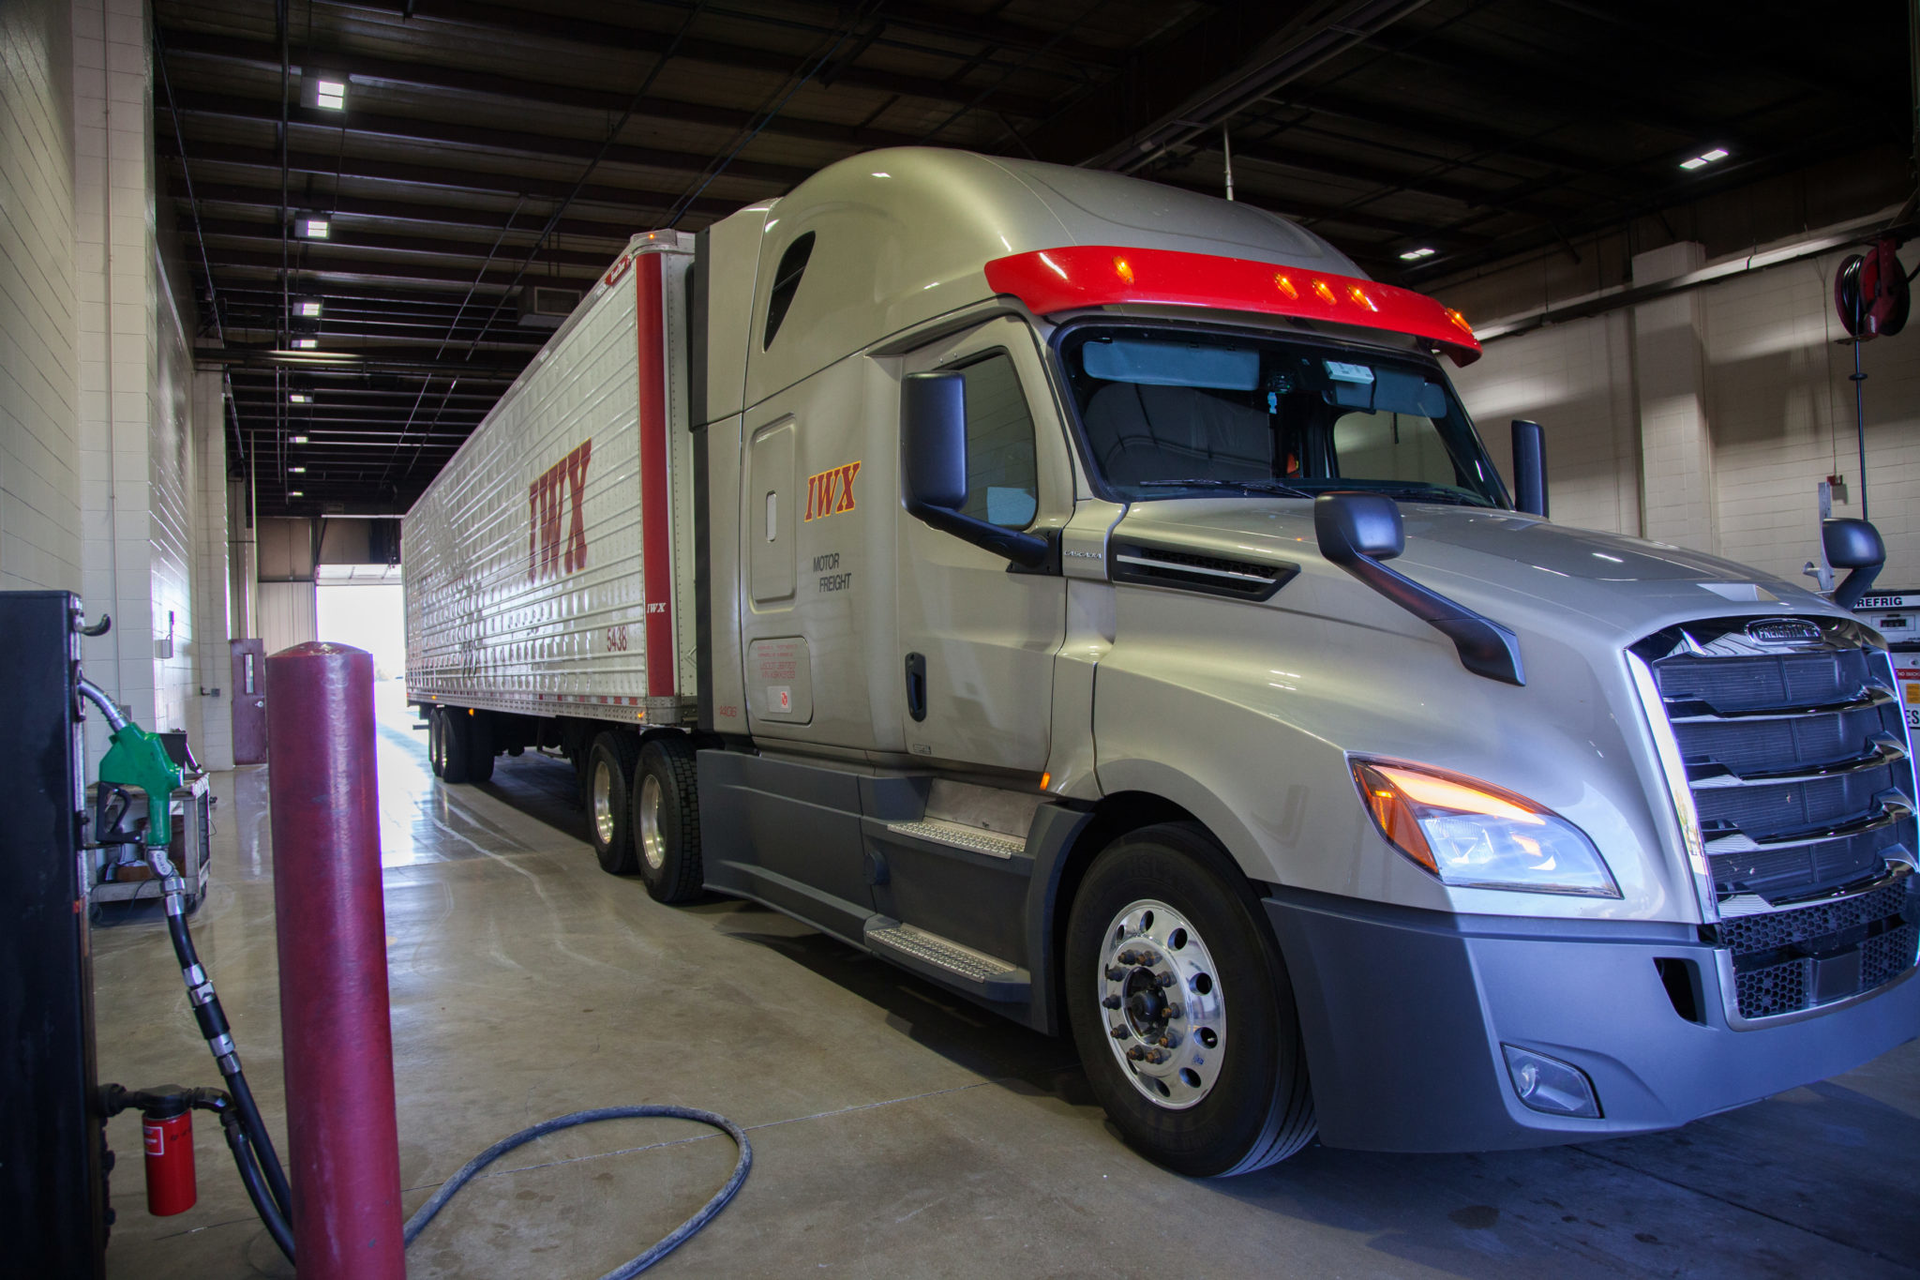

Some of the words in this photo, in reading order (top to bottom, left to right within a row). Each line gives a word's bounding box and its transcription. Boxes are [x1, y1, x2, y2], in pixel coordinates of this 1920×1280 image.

[804, 460, 862, 522] IWX
[529, 437, 592, 584] IWX
[813, 552, 840, 572] MOTOR
[819, 572, 852, 592] FREIGHT
[646, 602, 667, 614] IWX
[1857, 596, 1903, 607] REFRIG
[606, 626, 627, 652] 5438
